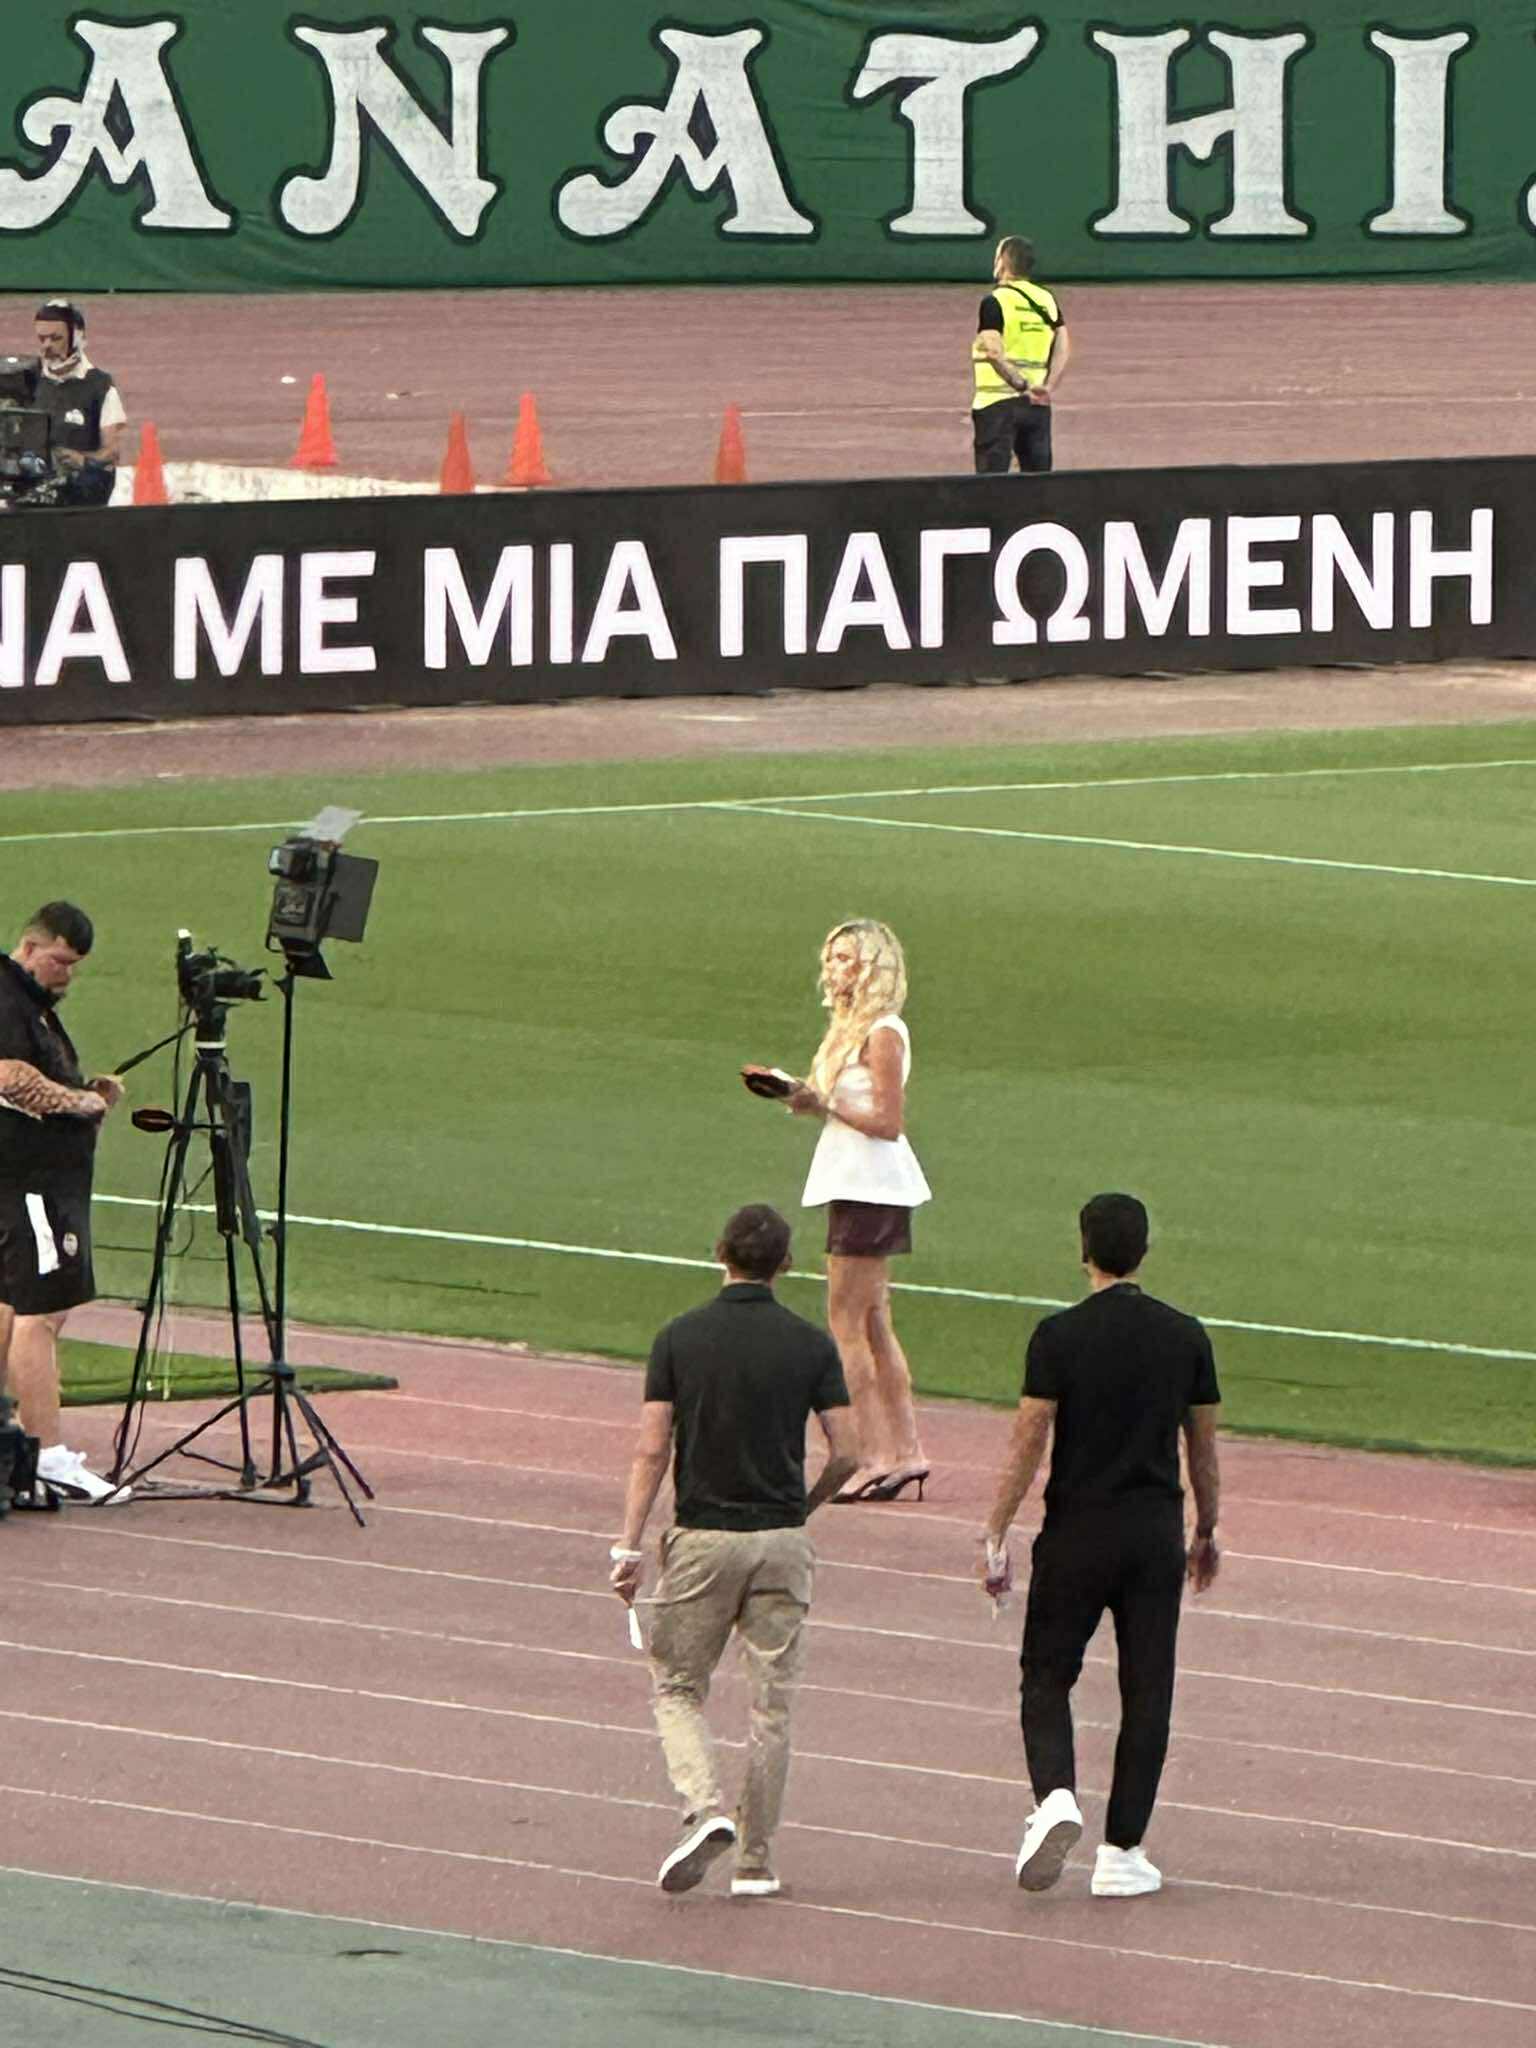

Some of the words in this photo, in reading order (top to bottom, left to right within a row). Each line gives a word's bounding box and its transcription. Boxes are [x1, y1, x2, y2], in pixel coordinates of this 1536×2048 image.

[0, 19, 1536, 236] ANATHI
[174, 550, 377, 680] ΜΕ
[424, 540, 678, 669] ΜΙΑ
[719, 508, 1494, 657] ΠΑΓΩΜΕΝΗ
